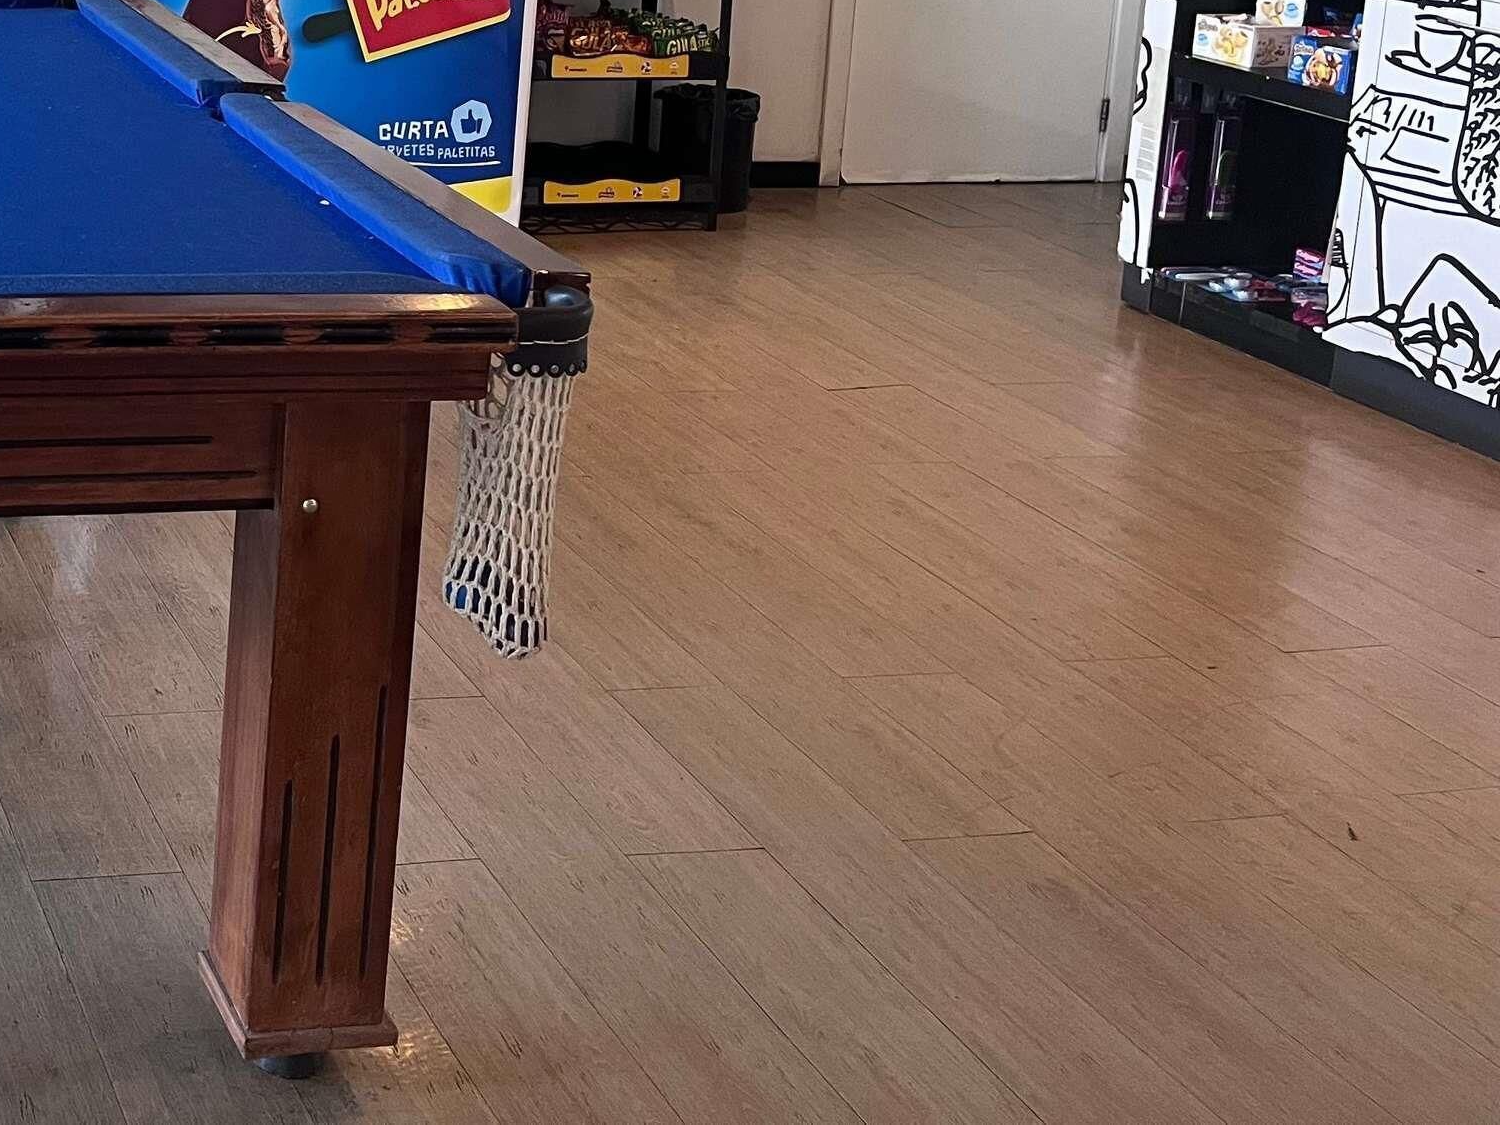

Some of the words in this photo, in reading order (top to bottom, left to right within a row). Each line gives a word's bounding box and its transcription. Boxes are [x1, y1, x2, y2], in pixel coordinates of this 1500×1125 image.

[378, 119, 450, 141] CURTA
[380, 143, 435, 157] RVETES
[437, 145, 496, 160] PALETITAS
